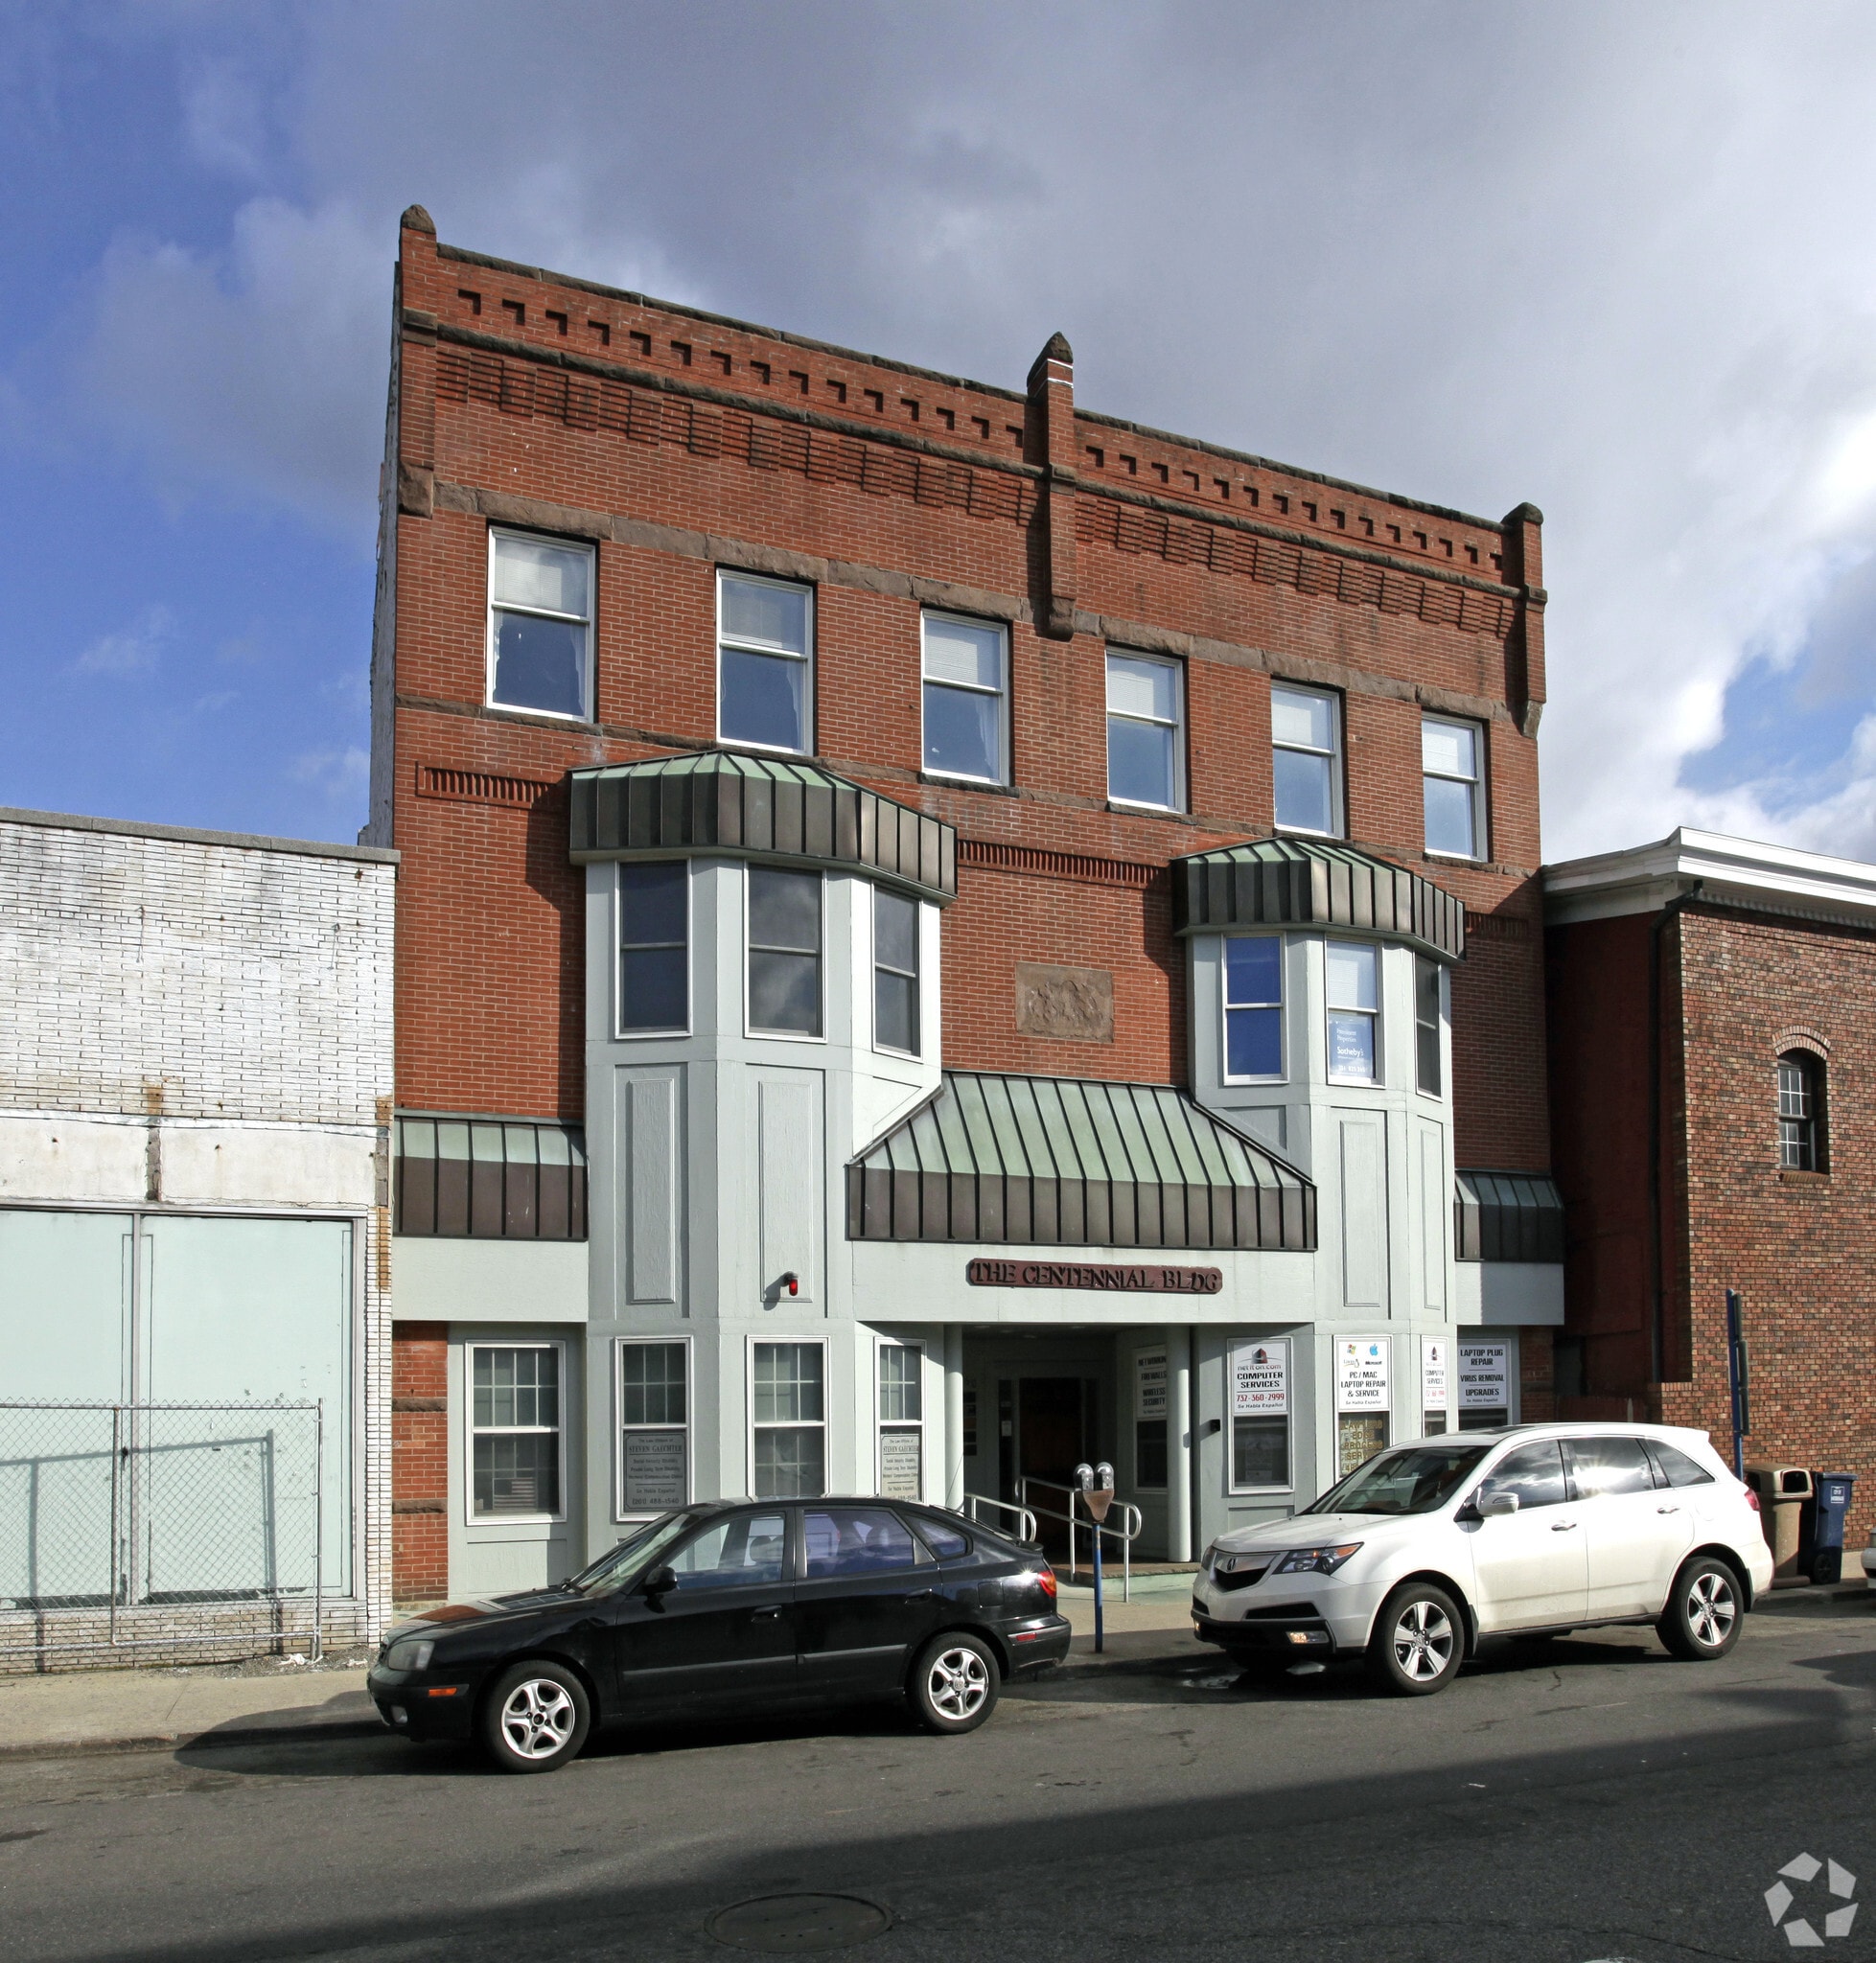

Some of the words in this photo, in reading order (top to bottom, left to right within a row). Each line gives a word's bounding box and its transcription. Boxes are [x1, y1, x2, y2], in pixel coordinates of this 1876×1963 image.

[1336, 1046, 1364, 1058] Sotheby's
[970, 1262, 1016, 1283] THE
[1022, 1264, 1155, 1289] CENTENNIAL
[1161, 1270, 1218, 1291] BLDG
[1460, 1349, 1486, 1357] LAPTOP
[1471, 1357, 1494, 1366] REPAIR
[1237, 1371, 1284, 1380] COMPUTER
[1349, 1371, 1358, 1379] PC
[1478, 1374, 1504, 1382] REMOVAL
[1240, 1380, 1280, 1389] SERVICES
[1340, 1380, 1364, 1389] LAPTOP
[1365, 1379, 1386, 1388] REPAIR
[1355, 1389, 1379, 1397] SERVICE
[1465, 1388, 1500, 1397] UPGRADES
[629, 1444, 651, 1453] STEVEN
